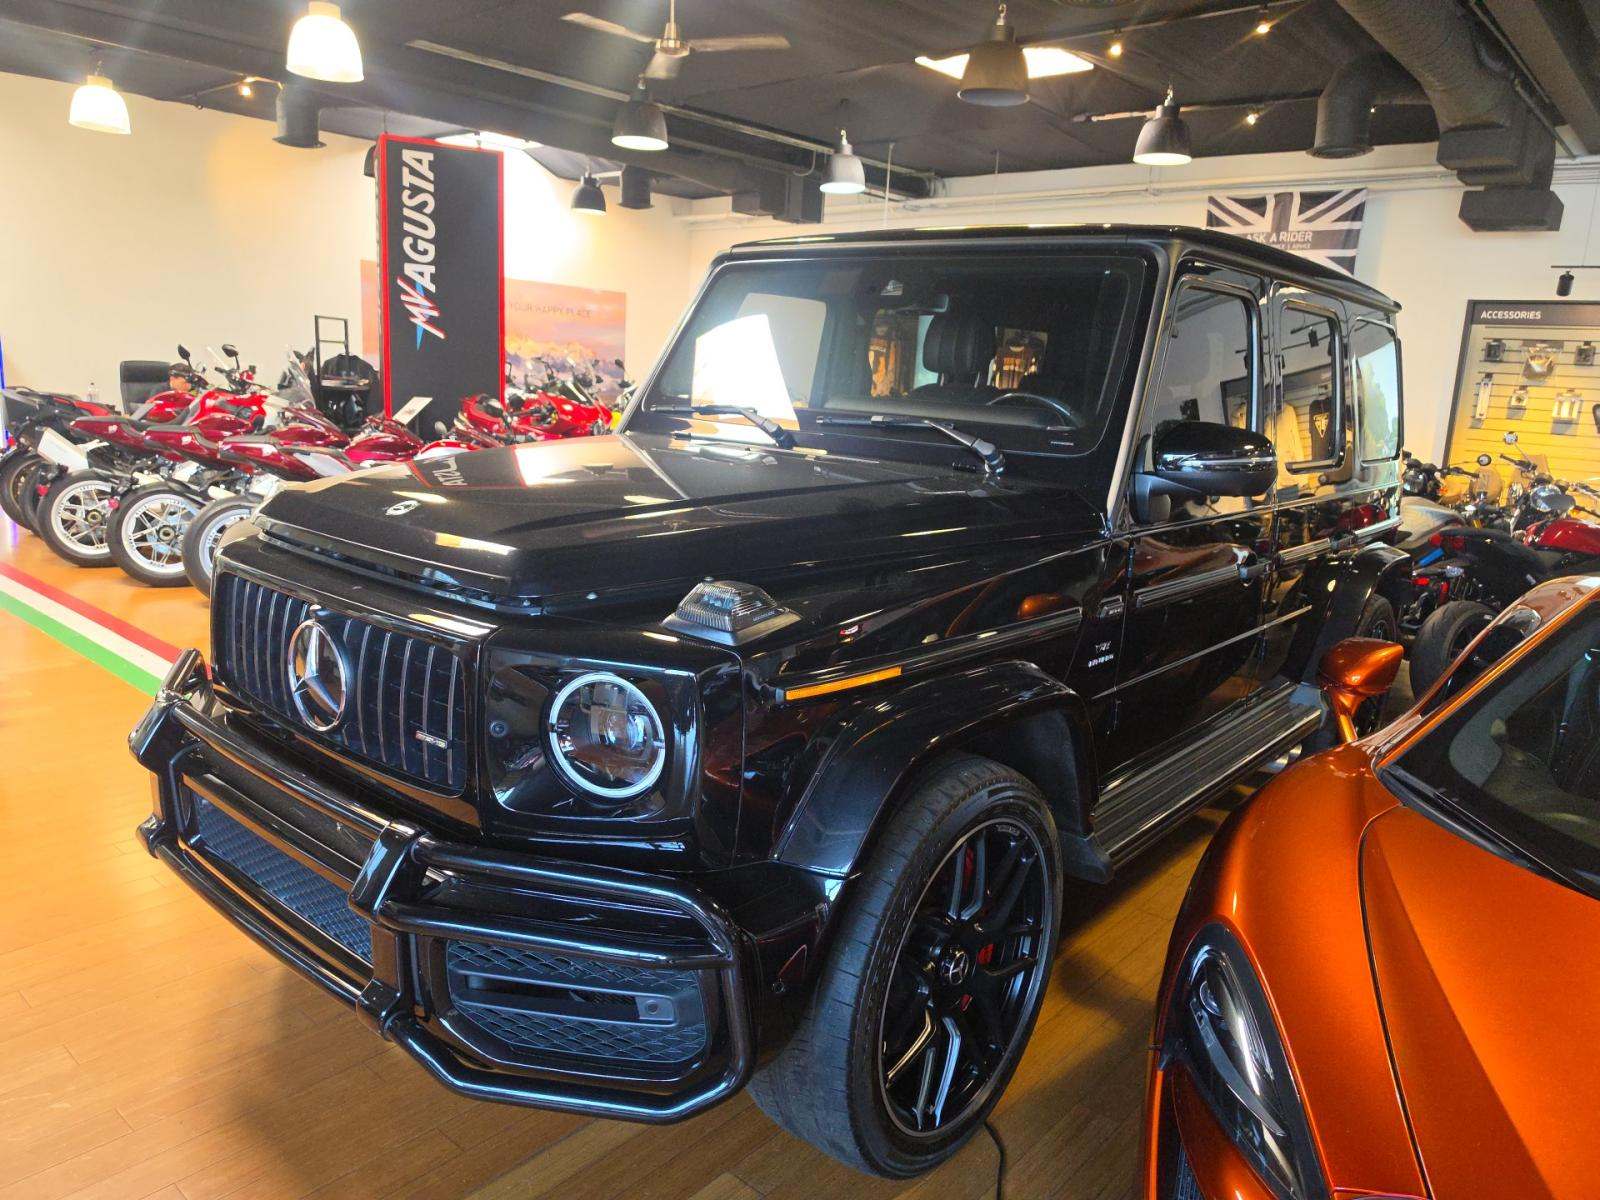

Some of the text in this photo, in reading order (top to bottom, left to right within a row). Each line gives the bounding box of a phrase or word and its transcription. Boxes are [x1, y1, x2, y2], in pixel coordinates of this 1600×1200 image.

[402, 149, 436, 293] AGUSTA
[1269, 232, 1277, 243] A
[1279, 231, 1313, 242] RIDER
[1480, 310, 1542, 320] ACCESSORIES
